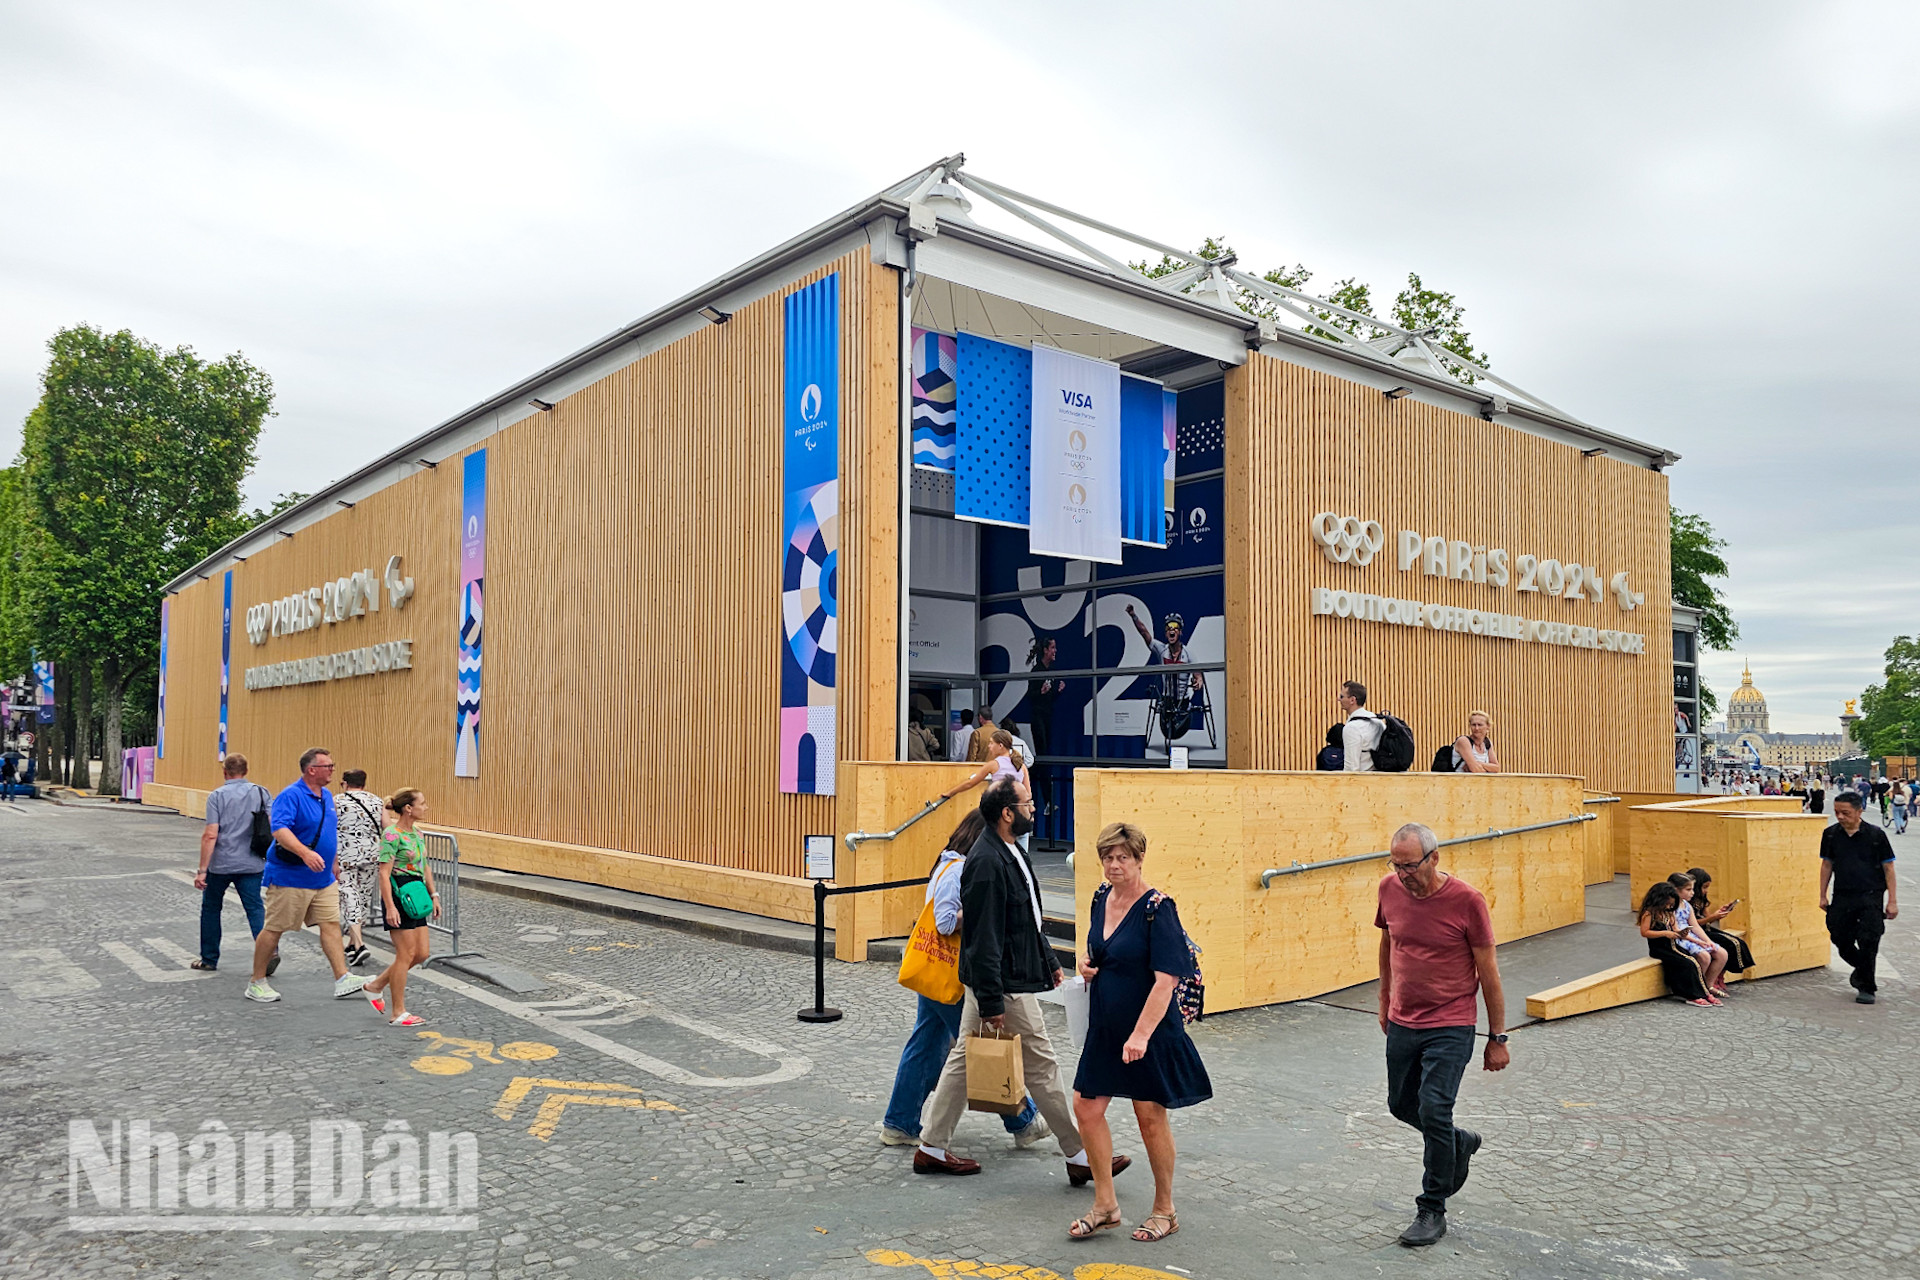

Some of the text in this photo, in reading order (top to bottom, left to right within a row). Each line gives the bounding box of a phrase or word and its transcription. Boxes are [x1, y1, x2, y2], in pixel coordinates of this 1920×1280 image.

[1060, 388, 1093, 410] VISA
[812, 420, 827, 431] 2024
[323, 568, 380, 624] 2024
[1516, 553, 1603, 603] 2024
[1312, 587, 1646, 655] BOUTIQUE OFFICIELLE OFFICIAL STORE
[925, 940, 956, 968] Company
